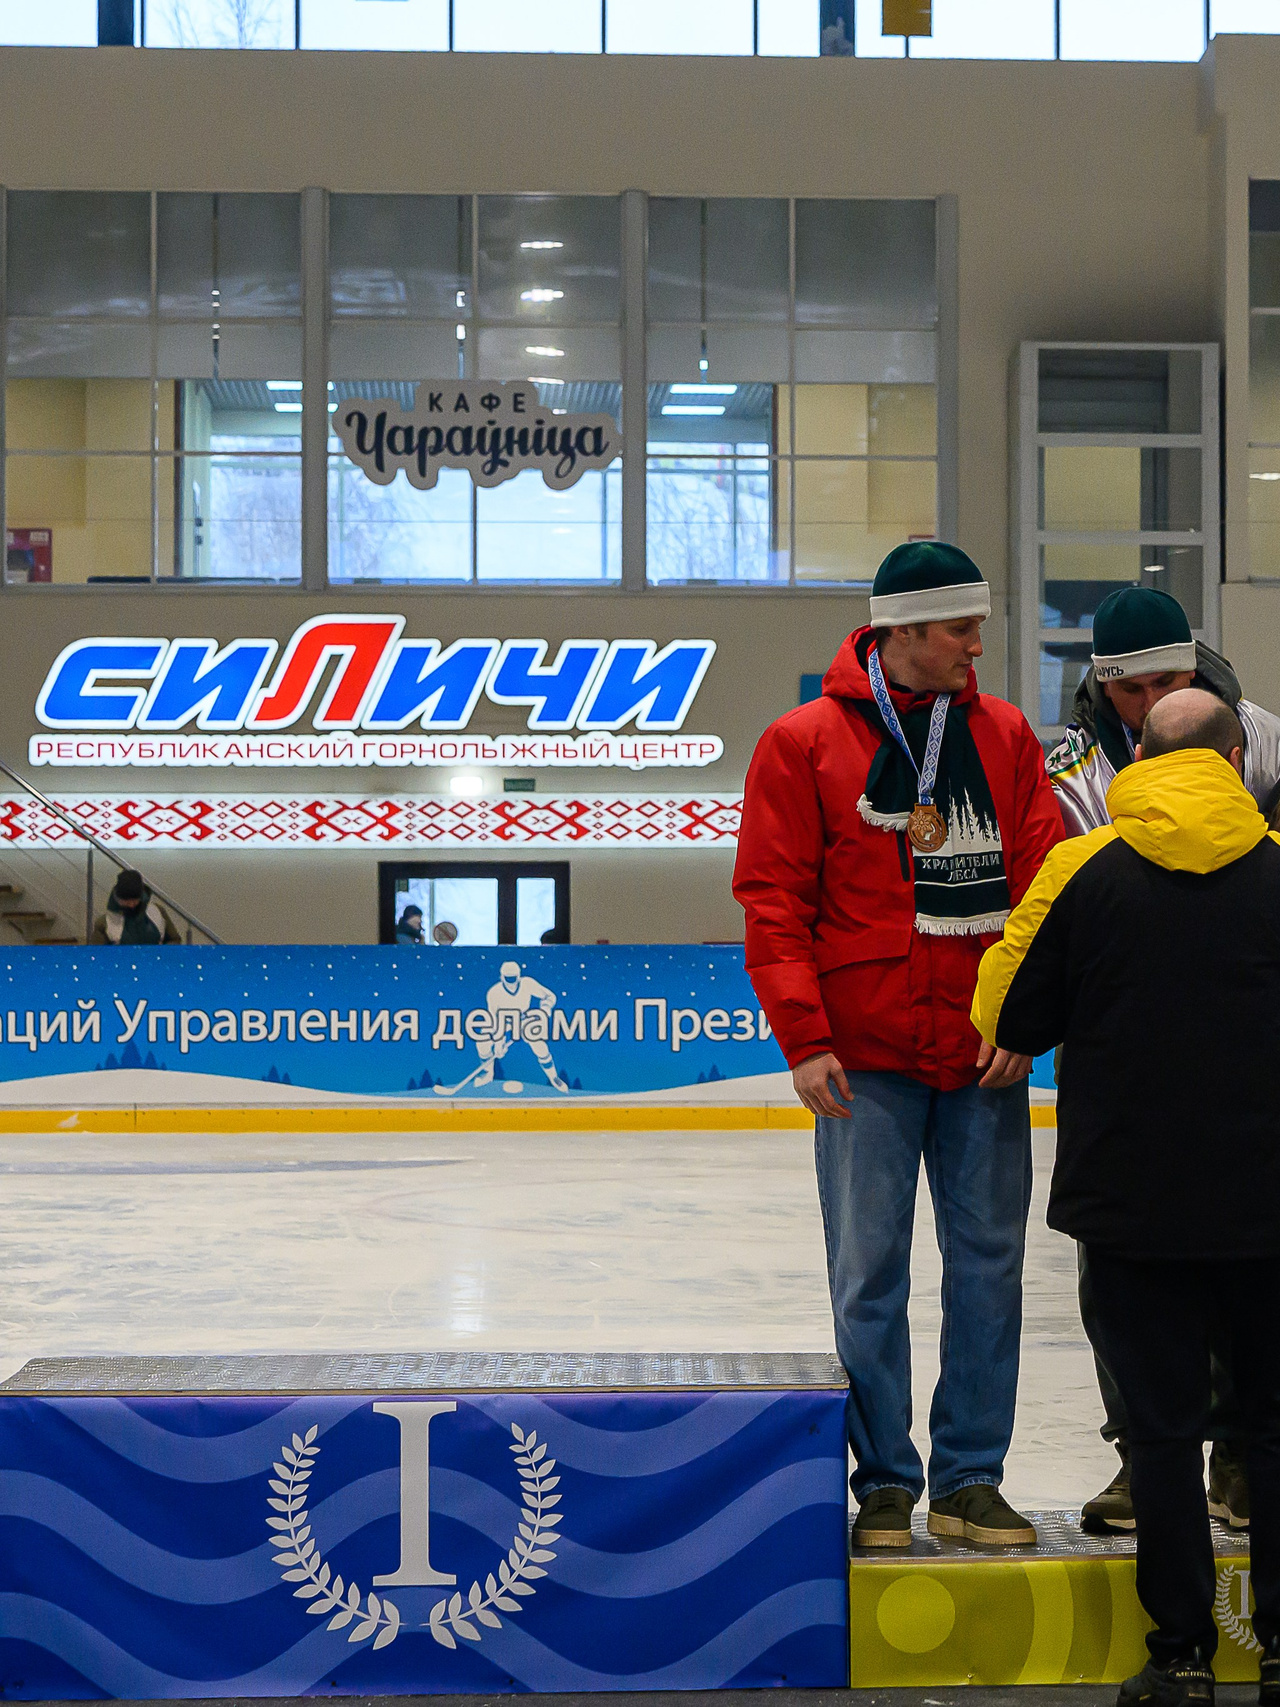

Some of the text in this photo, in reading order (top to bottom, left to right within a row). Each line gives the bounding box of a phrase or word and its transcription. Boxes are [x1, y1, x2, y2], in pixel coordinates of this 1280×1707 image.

[428, 392, 526, 413] КАФЕ
[345, 411, 610, 478] Чараўніца
[36, 737, 716, 764] РЕСПУБЛИКАНСКИЙ ГОРНОЛЫЖНЫЙ ЦЕНТР
[0, 999, 101, 1053] ций
[113, 999, 420, 1054] Управления
[432, 1008, 619, 1051] делами
